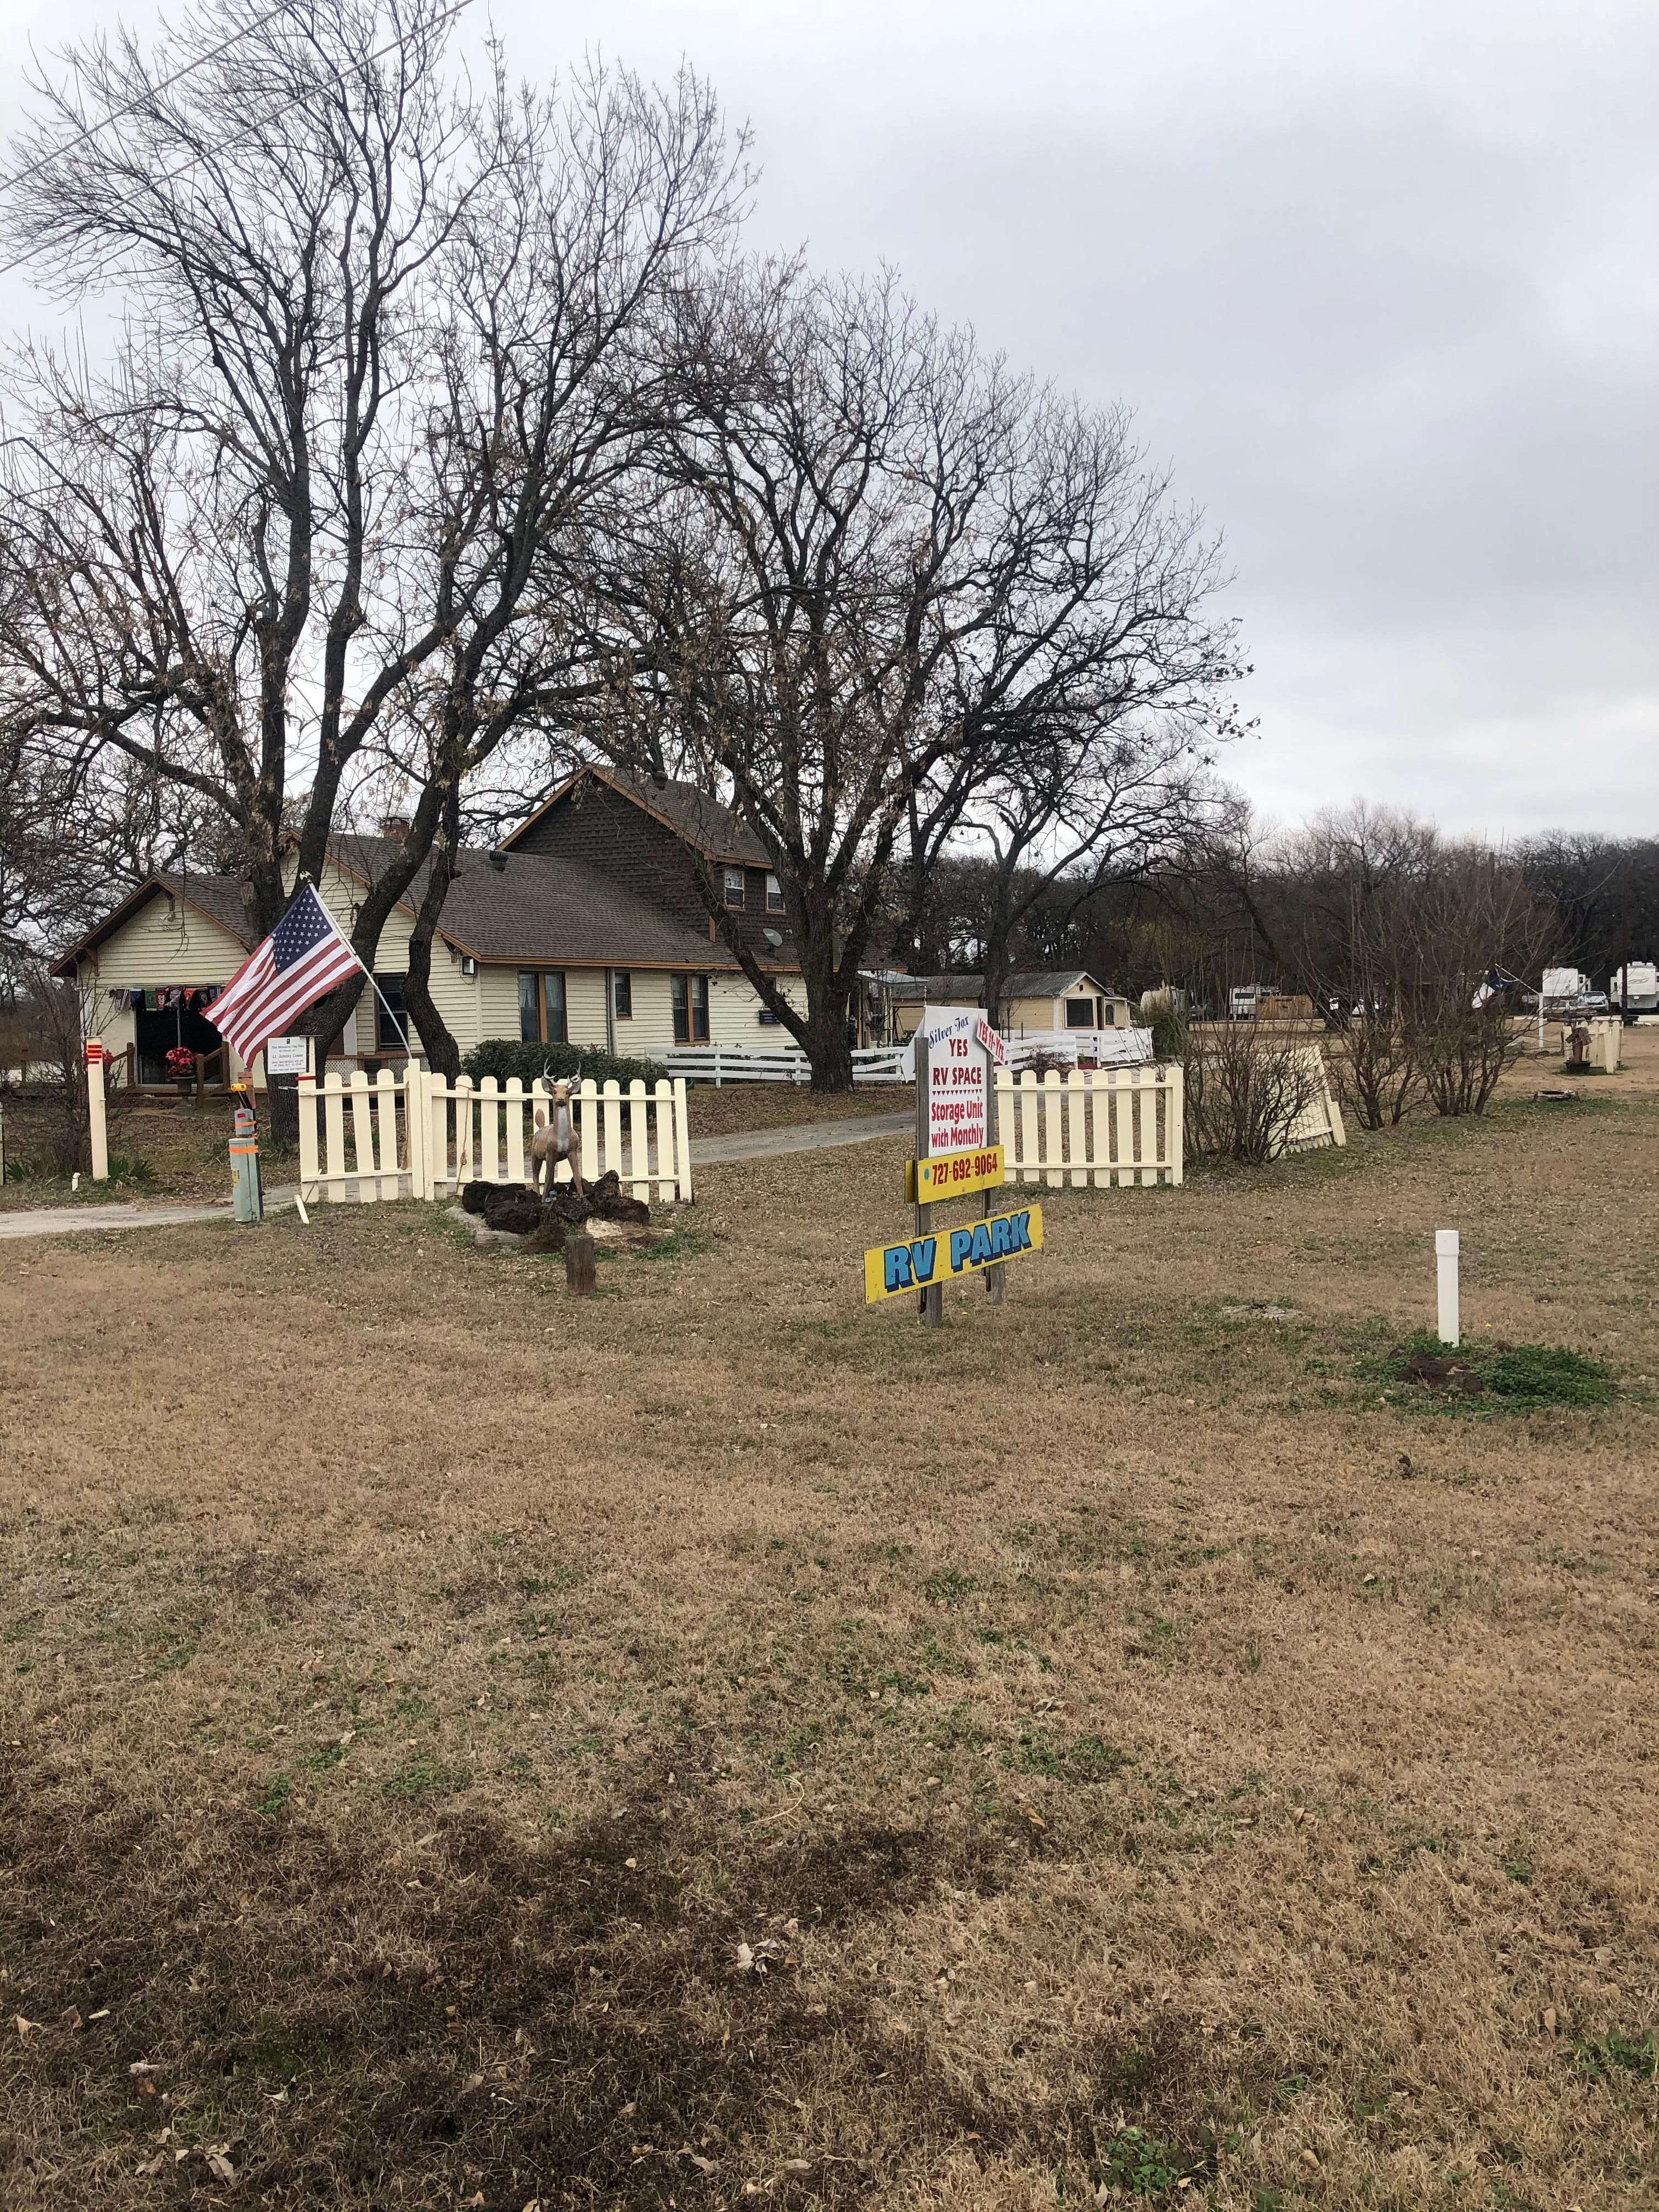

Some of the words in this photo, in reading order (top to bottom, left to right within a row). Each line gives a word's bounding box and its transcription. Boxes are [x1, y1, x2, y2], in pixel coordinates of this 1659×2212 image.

[929, 1024, 952, 1049] Silver
[955, 1015, 969, 1032] Fox
[979, 1018, 988, 1044] YES
[949, 1039, 968, 1057] YES
[933, 1067, 949, 1085] RV
[952, 1066, 981, 1085] SPACE
[932, 1102, 964, 1125] Storage
[966, 1096, 983, 1119] Unit
[931, 1127, 949, 1148] with
[951, 1123, 984, 1149] Monthly
[932, 1153, 998, 1186] 727-692-9064
[884, 1237, 937, 1293] RV
[950, 1210, 1032, 1273] PARK
